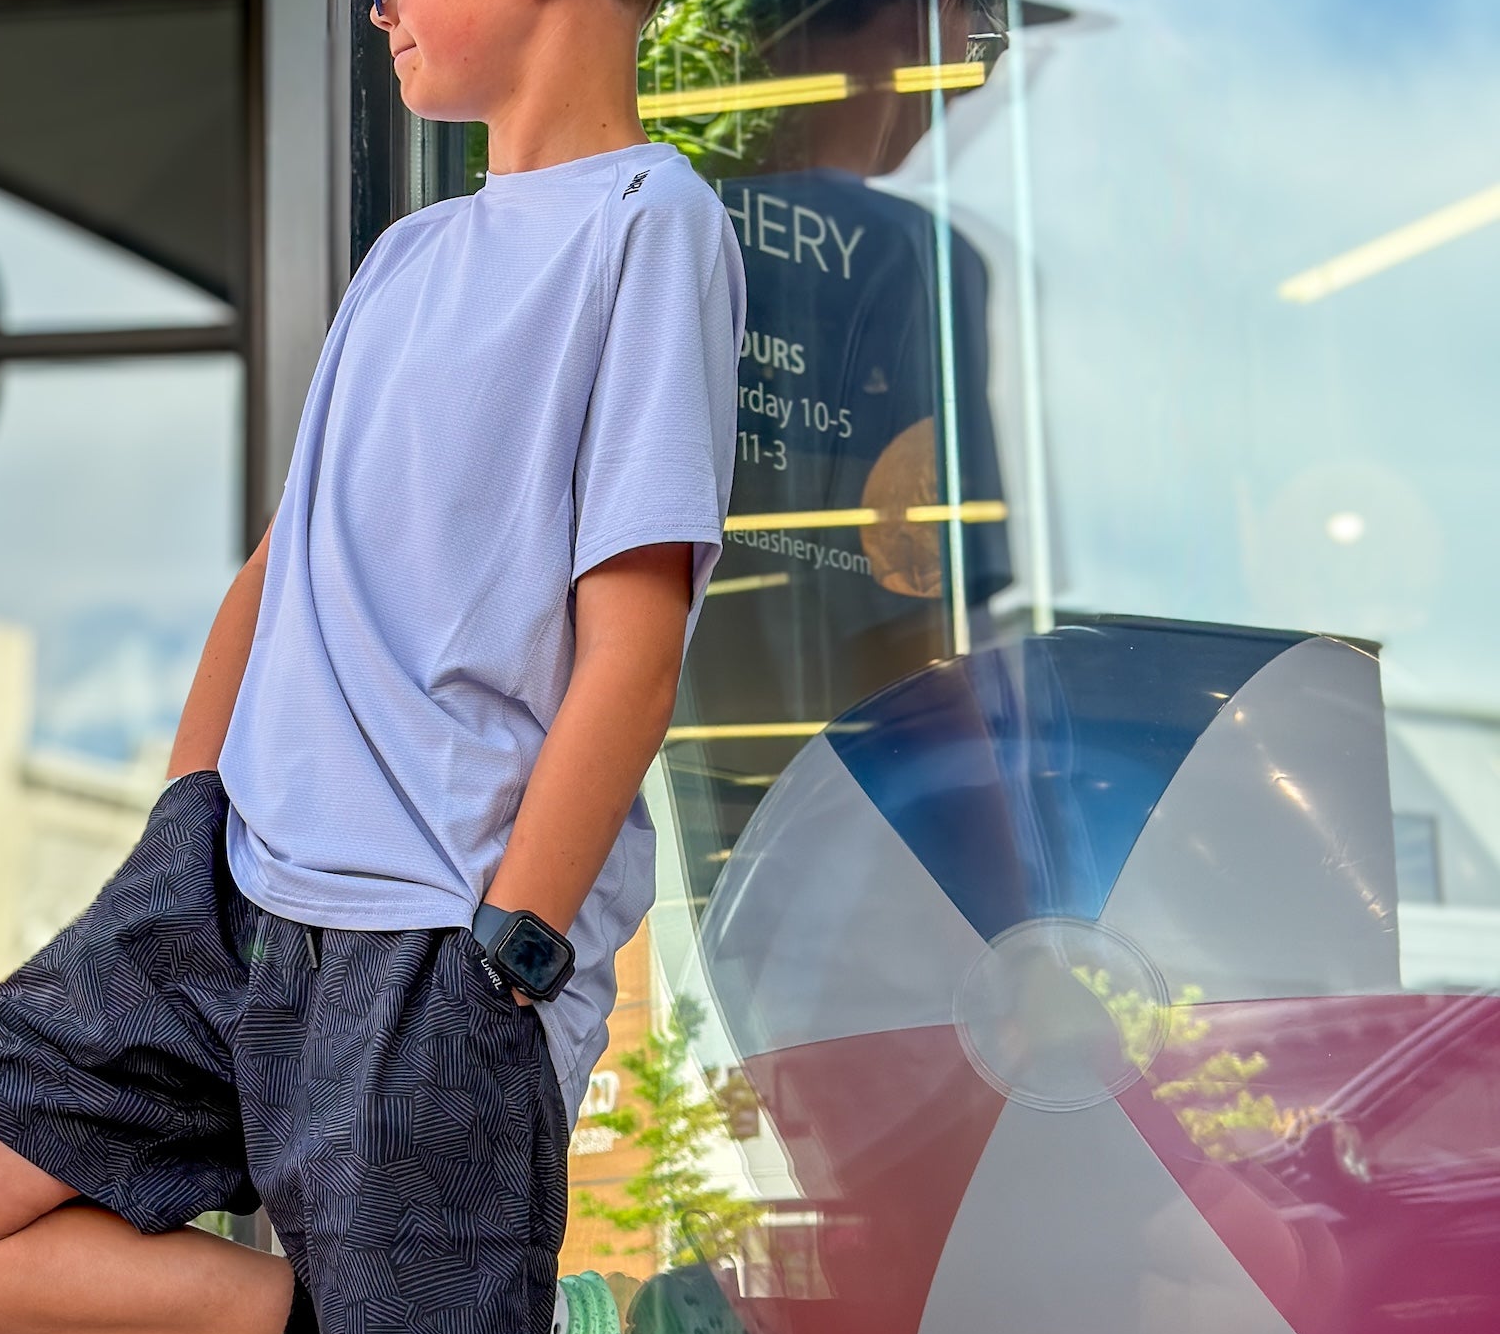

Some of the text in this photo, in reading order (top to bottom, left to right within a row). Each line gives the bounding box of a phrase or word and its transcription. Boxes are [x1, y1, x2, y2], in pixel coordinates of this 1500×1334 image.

[800, 397, 853, 439] 10-5
[737, 430, 788, 471] 11-3
[480, 957, 503, 991] UNRL
